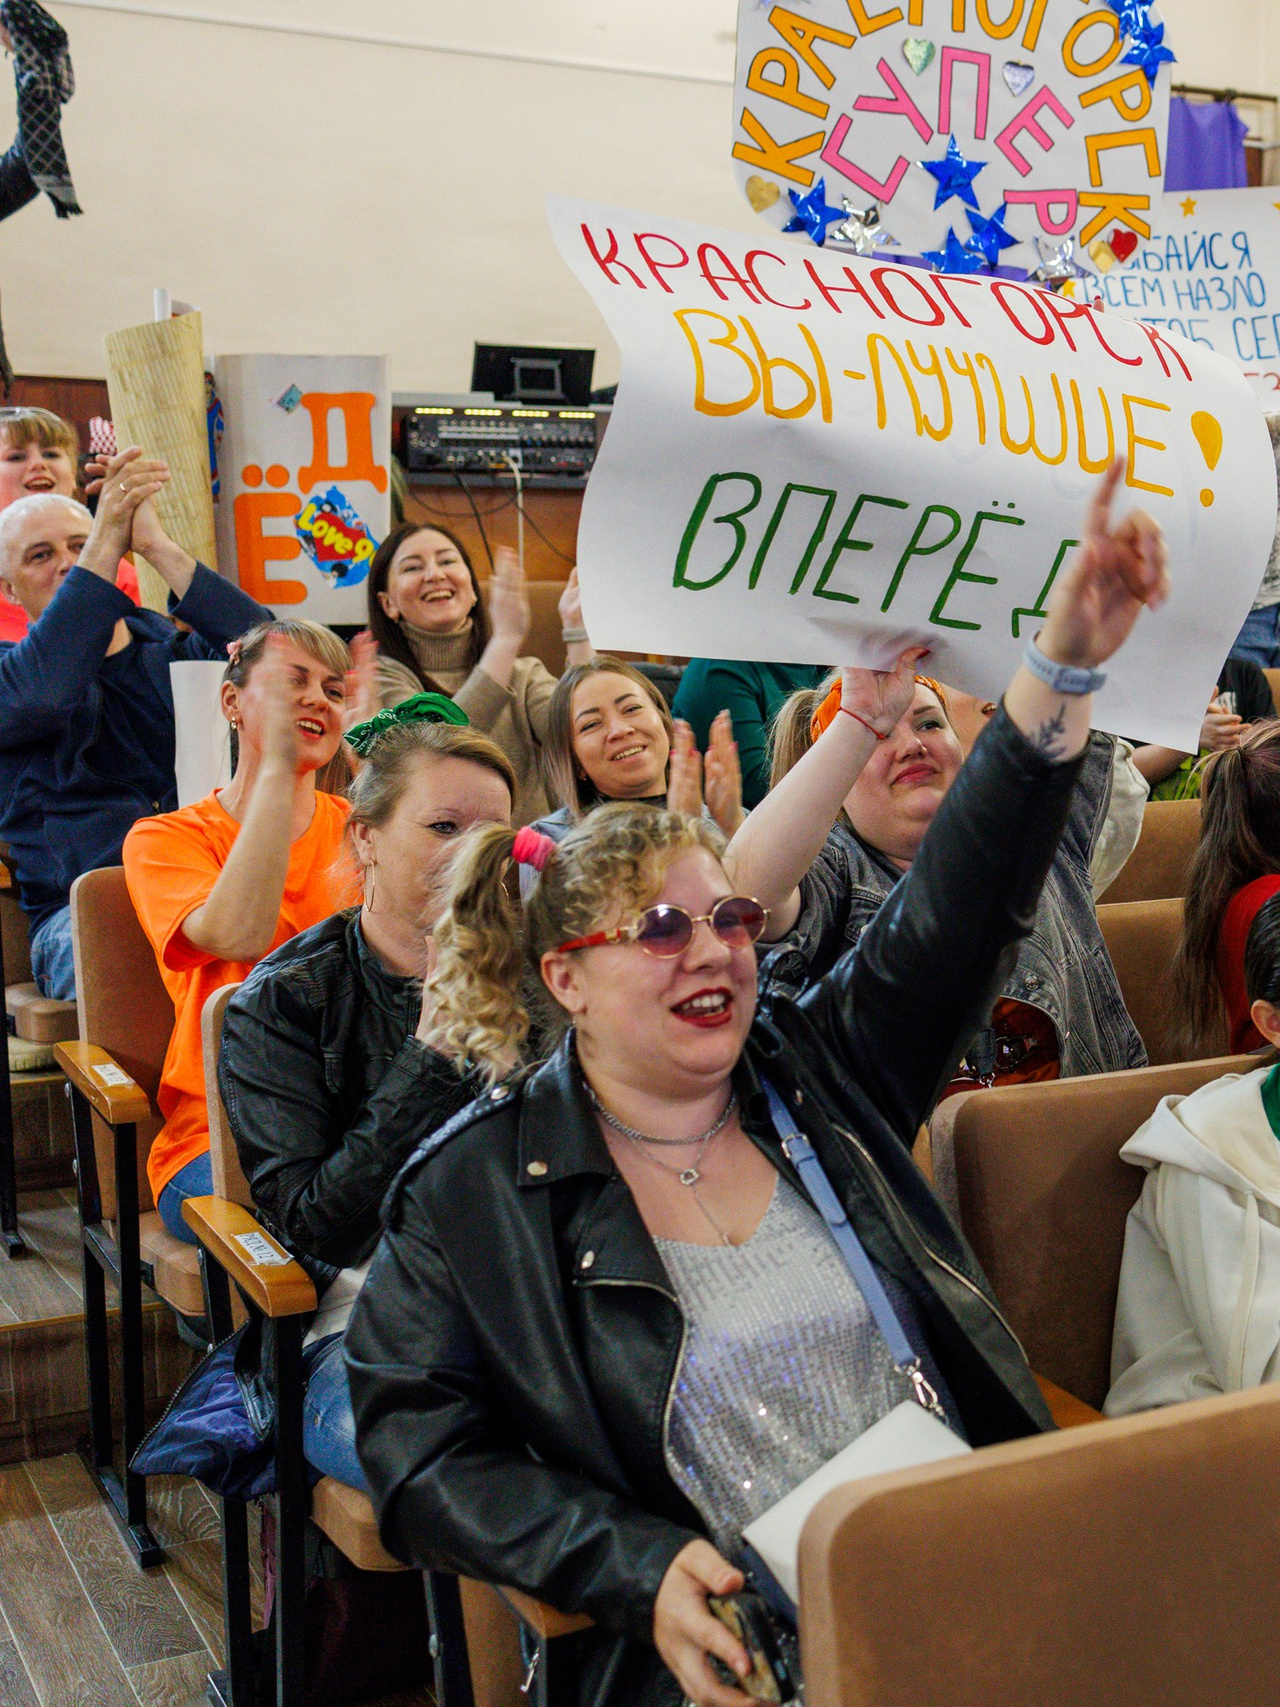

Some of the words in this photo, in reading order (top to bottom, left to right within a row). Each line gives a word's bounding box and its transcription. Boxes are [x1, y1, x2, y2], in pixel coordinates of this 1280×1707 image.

[820, 45, 1078, 236] СУПЕР
[1082, 273, 1166, 307] ВСЕМ
[1173, 271, 1267, 312] НАЗЛО
